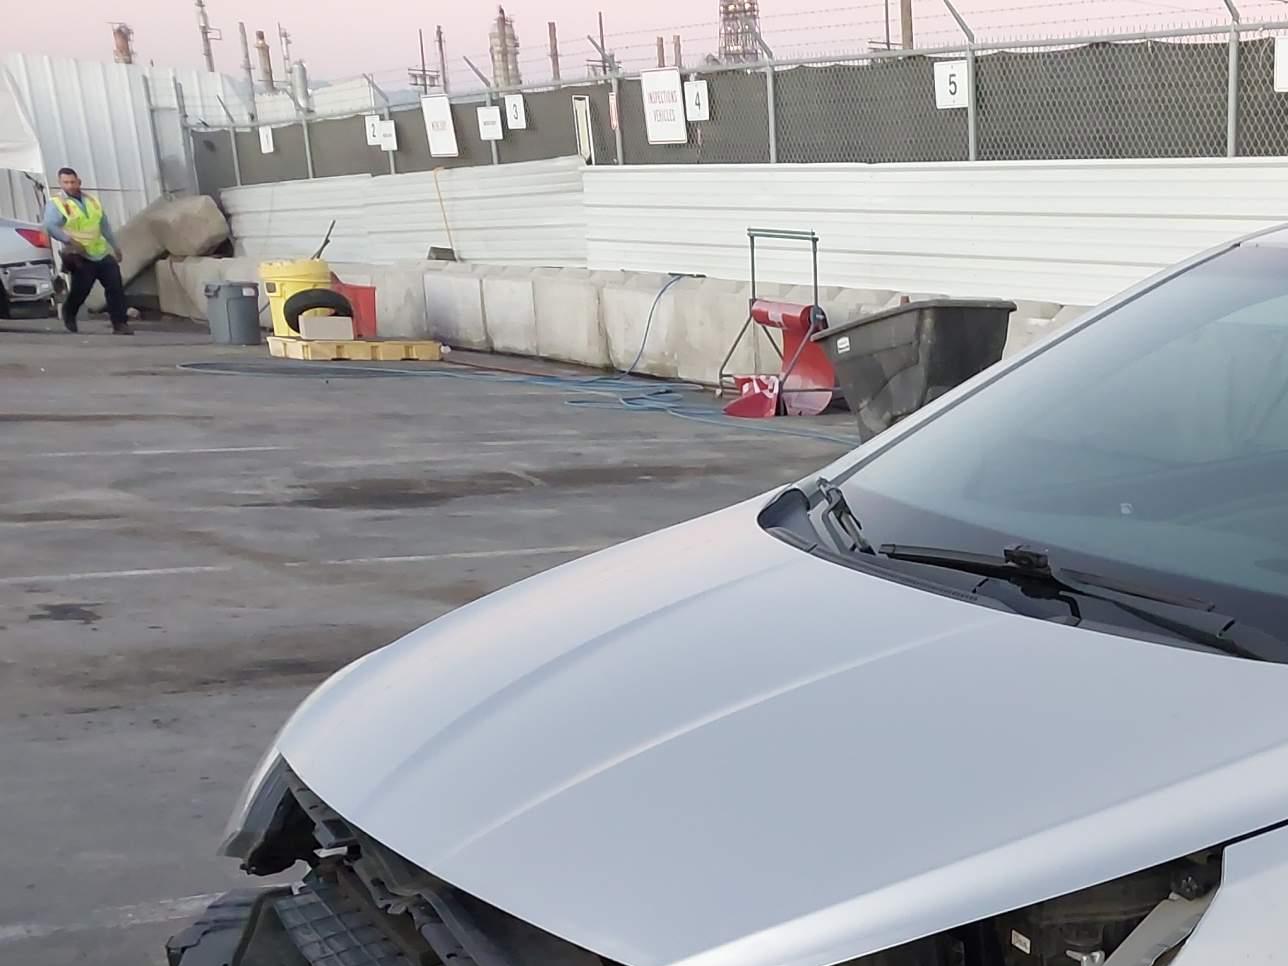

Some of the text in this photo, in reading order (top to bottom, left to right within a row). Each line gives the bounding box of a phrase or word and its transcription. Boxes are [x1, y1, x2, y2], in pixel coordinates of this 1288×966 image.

[948, 73, 958, 96] 5
[694, 91, 701, 111] 4
[511, 103, 519, 120] 3
[370, 122, 377, 139] 2
